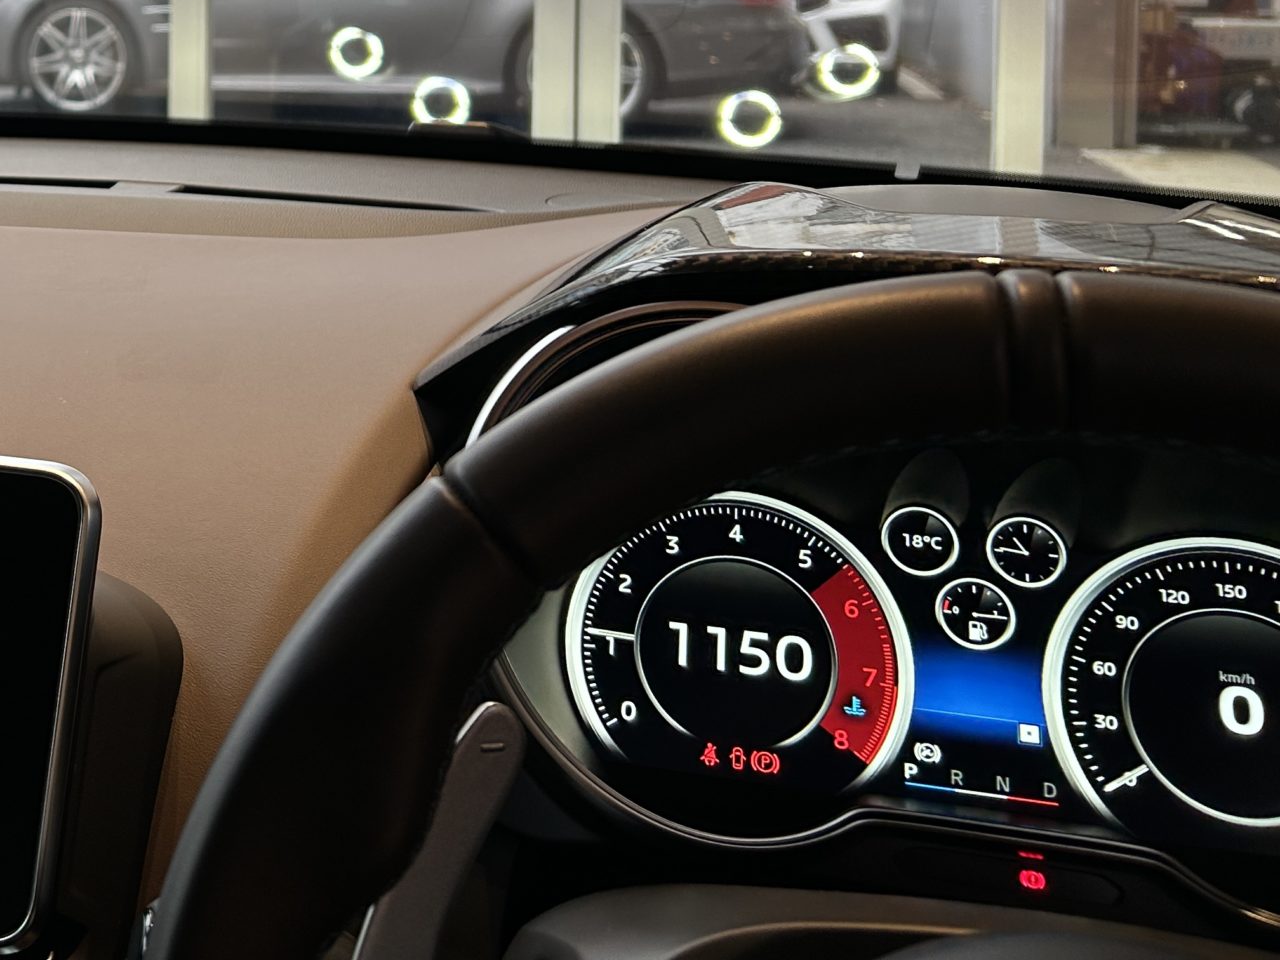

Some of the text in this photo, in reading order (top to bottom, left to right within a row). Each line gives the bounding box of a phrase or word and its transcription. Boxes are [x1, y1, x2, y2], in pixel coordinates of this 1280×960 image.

[728, 524, 743, 542] 4
[665, 535, 680, 554] 3
[798, 549, 812, 568] 5
[618, 574, 632, 594] 2
[1215, 583, 1247, 600] 150
[1159, 588, 1190, 605] 120
[844, 599, 859, 618] 6
[1116, 614, 1139, 631] 90
[668, 621, 813, 682] 1150
[862, 667, 878, 687] 7
[1092, 660, 1117, 677] 60
[1219, 670, 1256, 685] km/h
[620, 700, 637, 722] 0
[1219, 685, 1265, 736] 0
[1093, 713, 1119, 731] 30
[834, 729, 849, 750] 8
[904, 762, 1058, 799] P R N D
